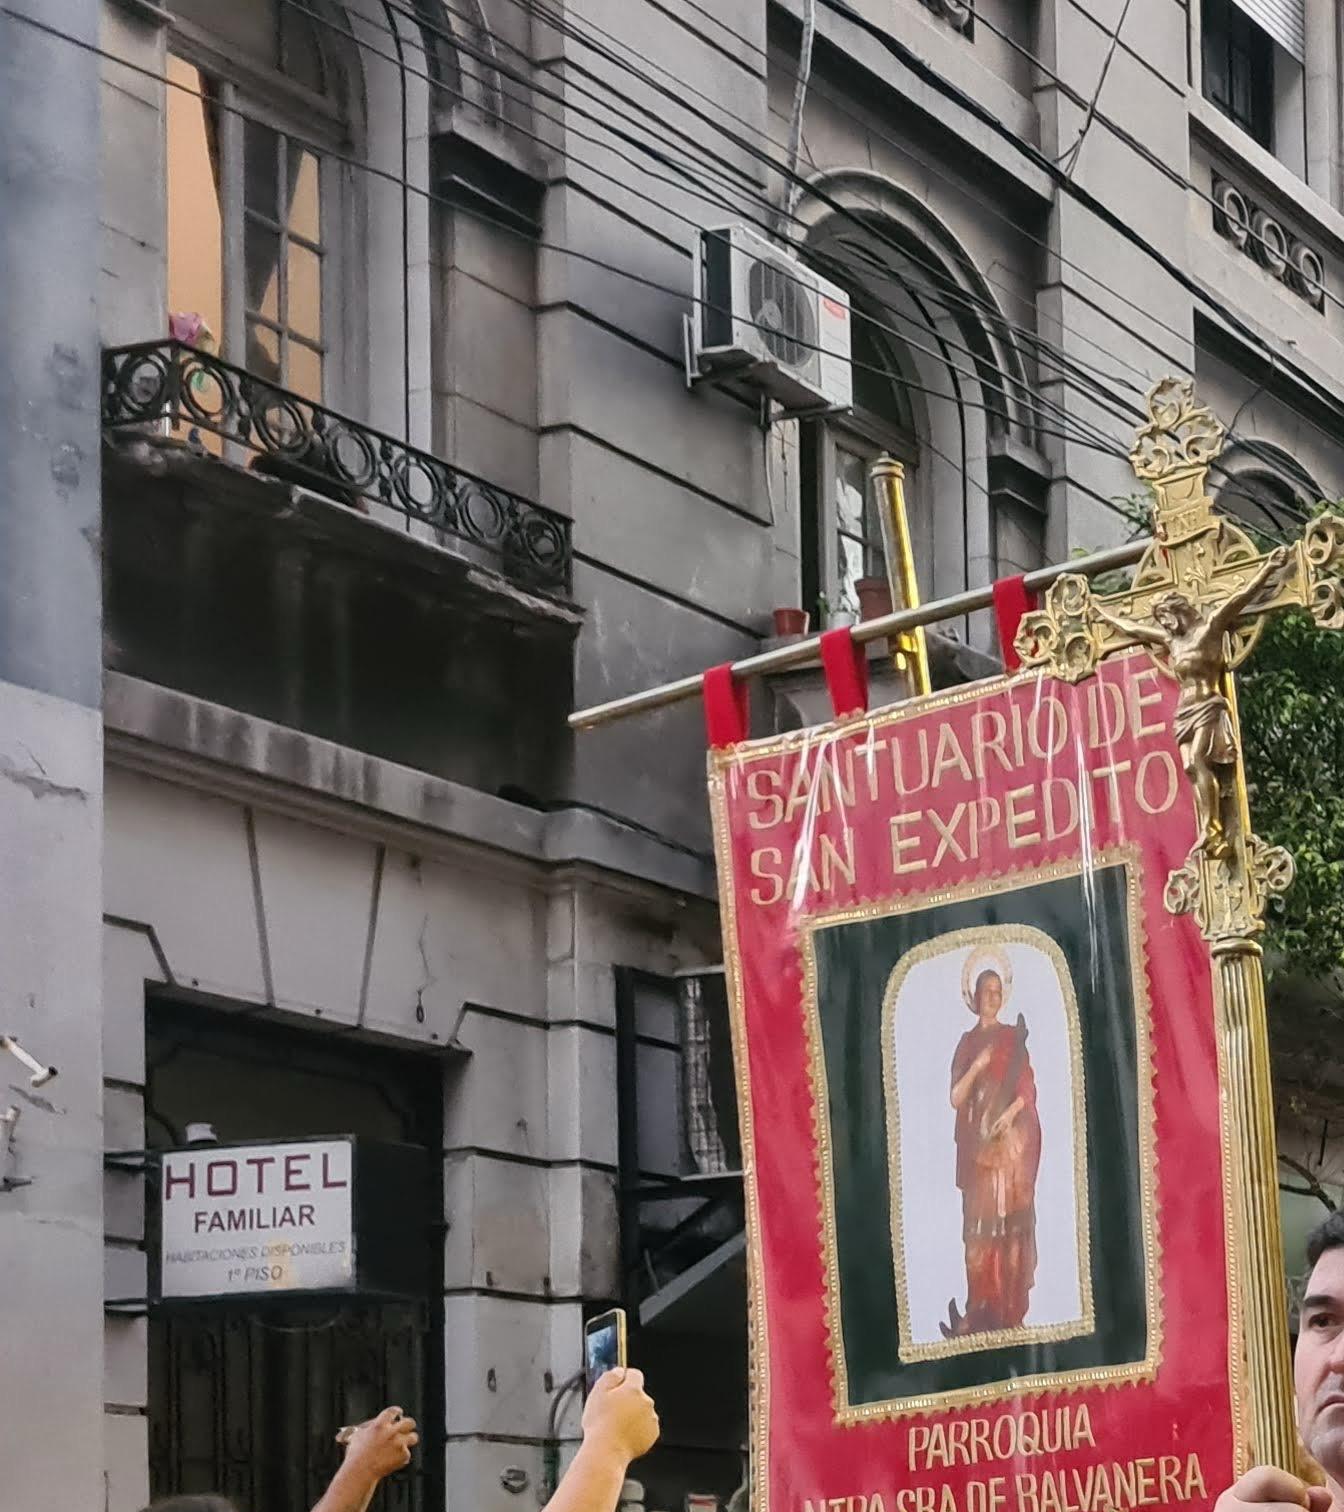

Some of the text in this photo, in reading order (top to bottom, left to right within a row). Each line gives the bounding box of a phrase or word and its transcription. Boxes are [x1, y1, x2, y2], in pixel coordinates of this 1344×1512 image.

[747, 666, 1167, 831] SANTUARIO DE
[750, 749, 1179, 905] SAN EXPEDITO
[165, 1152, 348, 1201] HOTEL
[194, 1204, 316, 1234] FAMILIAR
[244, 1265, 283, 1282] PISO
[260, 1240, 346, 1259] DISPONIBLES
[907, 1403, 1096, 1472] PARROQUIA
